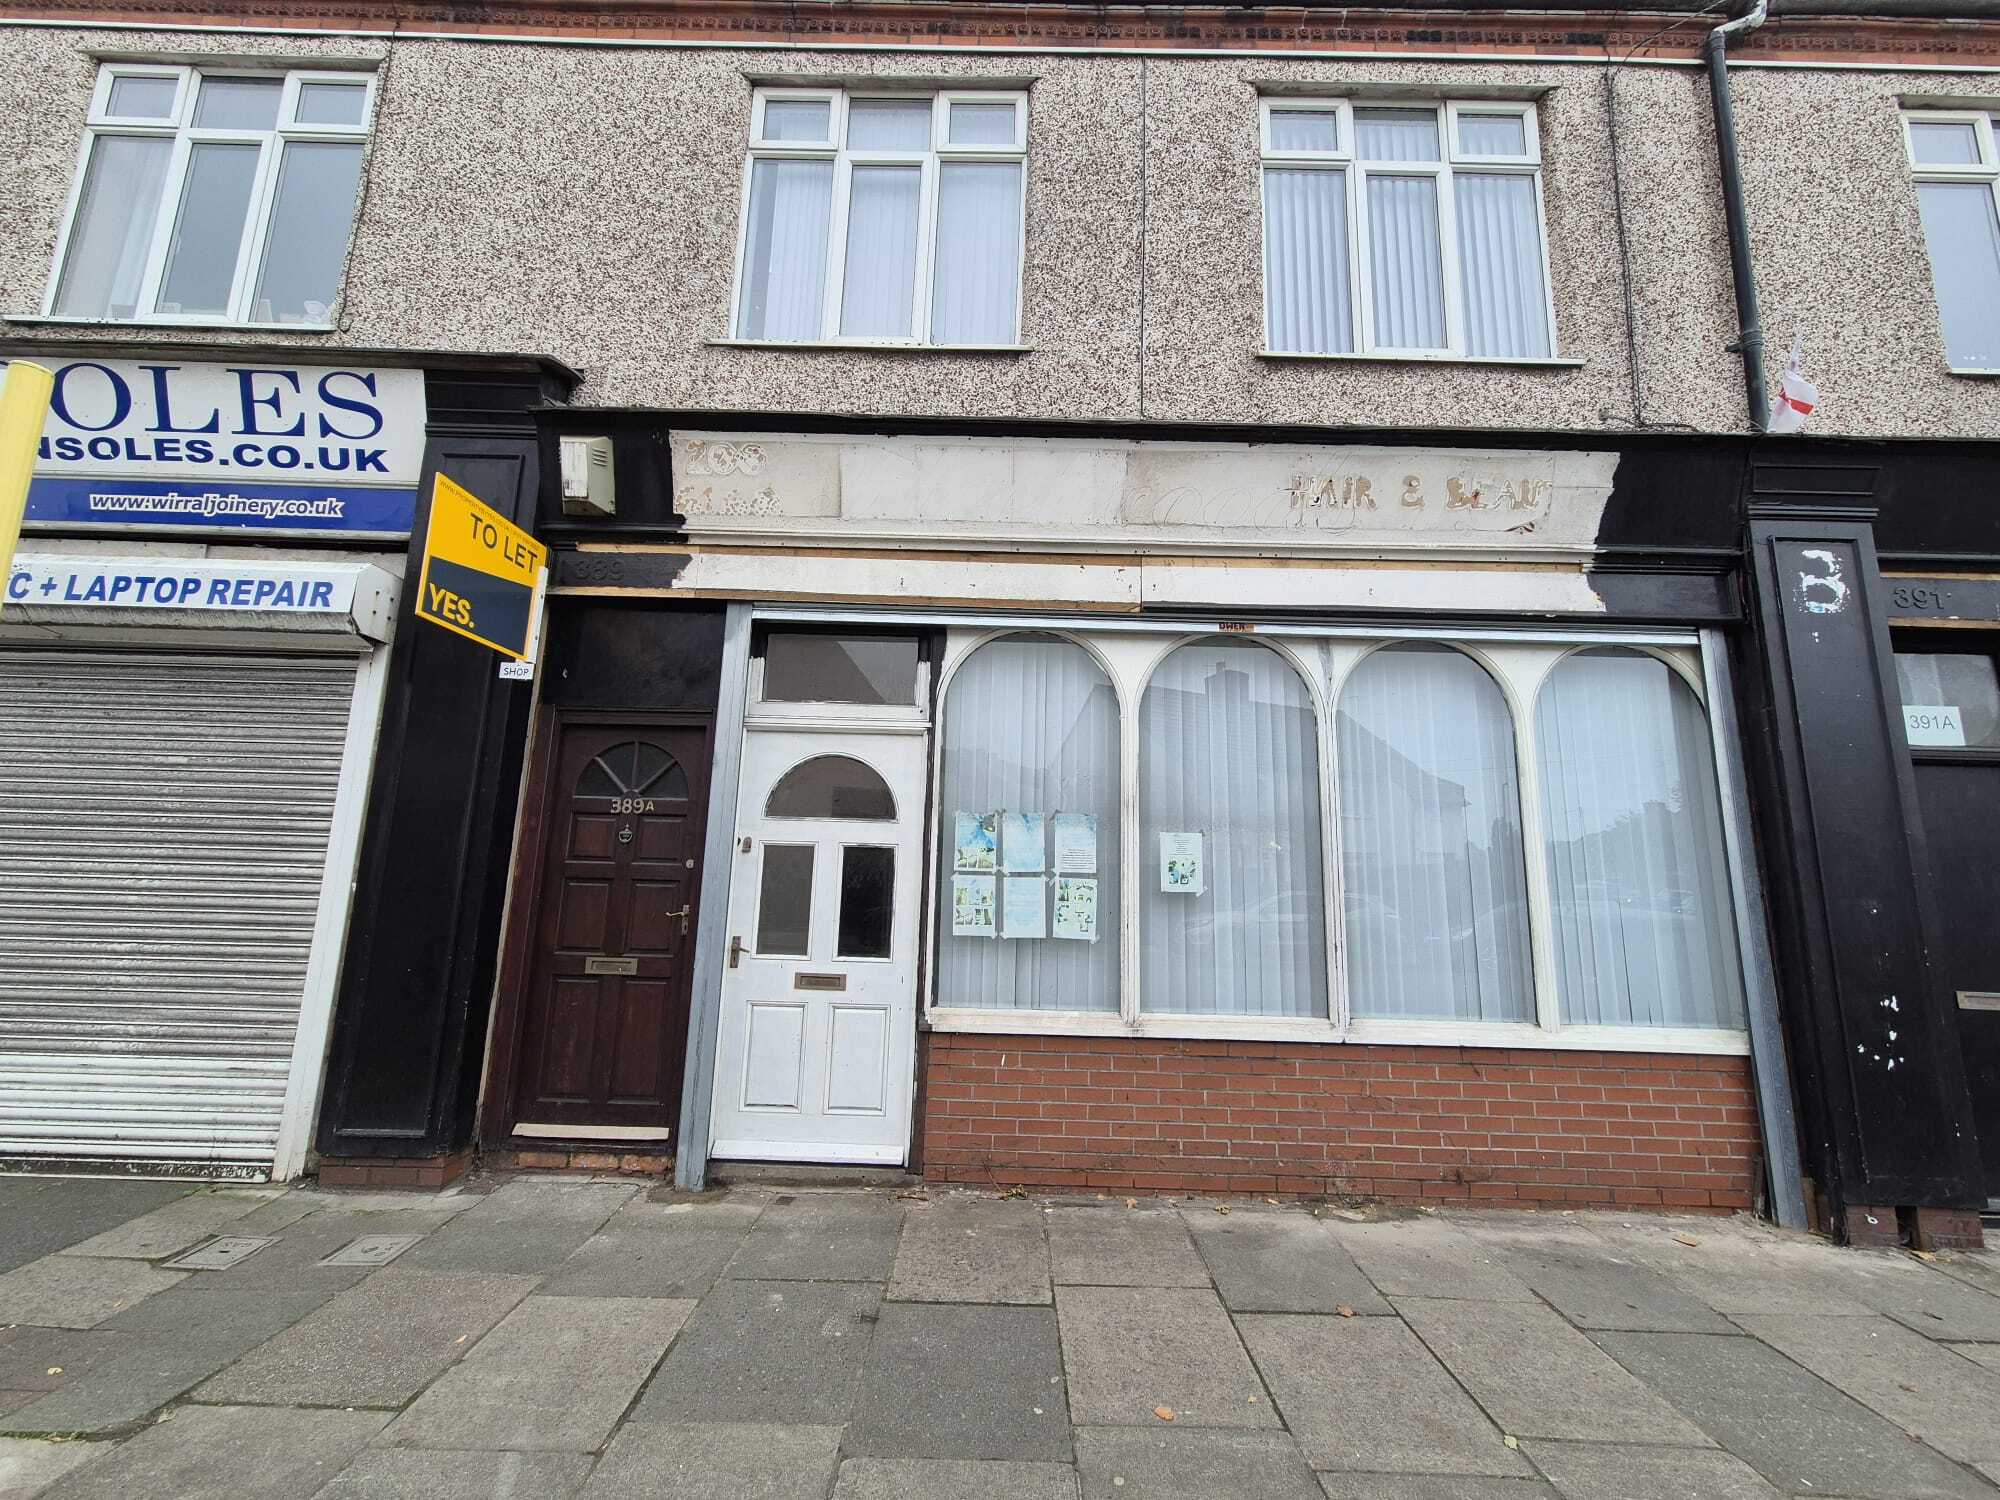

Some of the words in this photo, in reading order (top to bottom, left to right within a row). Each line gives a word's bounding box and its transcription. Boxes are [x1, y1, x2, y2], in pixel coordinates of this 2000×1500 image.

[0, 361, 384, 440] OLES
[90, 493, 343, 518] www.wirraljoinery.co.uk
[1401, 475, 1425, 510] &
[471, 512, 498, 549] TO
[504, 535, 538, 573] LET
[40, 577, 58, 596] +
[64, 574, 201, 605] LAPTOP
[206, 578, 334, 608] REPAIR
[429, 582, 475, 628] YES.
[1894, 588, 1945, 610] 391
[503, 667, 529, 676] SHOP
[1909, 714, 1956, 730] 391A
[610, 798, 655, 814] 389A
